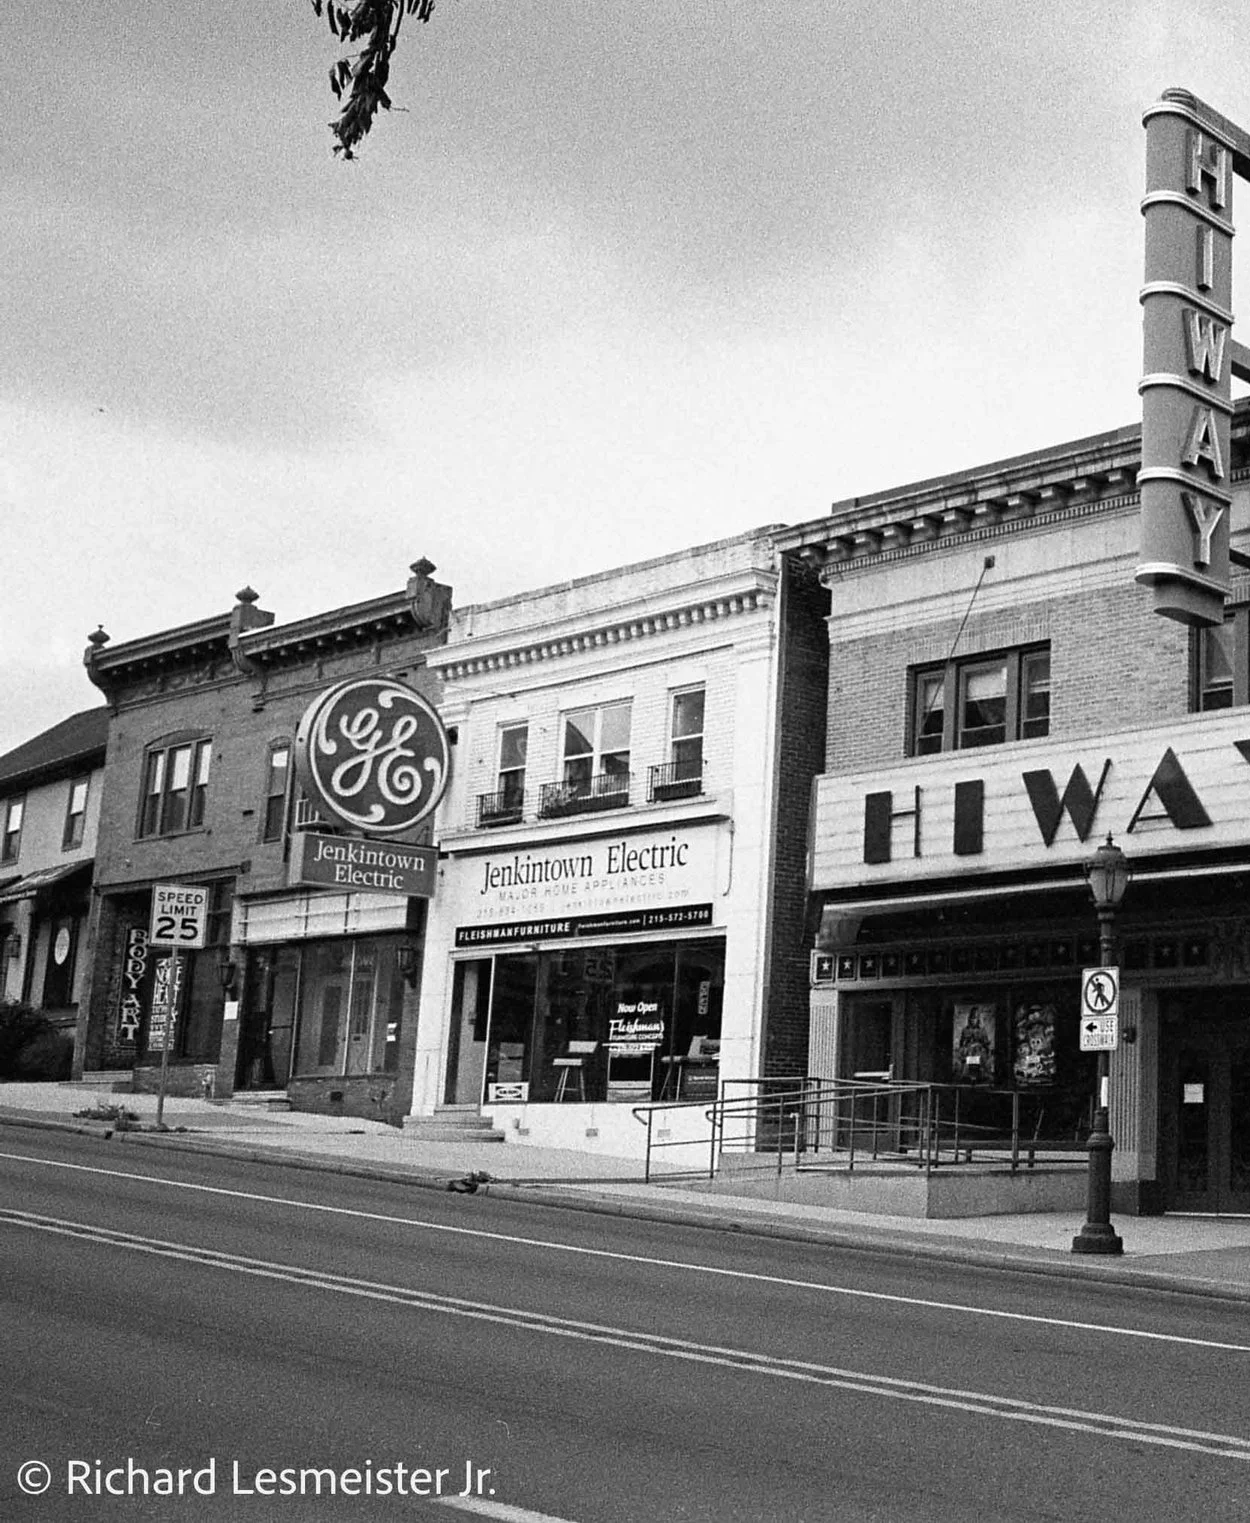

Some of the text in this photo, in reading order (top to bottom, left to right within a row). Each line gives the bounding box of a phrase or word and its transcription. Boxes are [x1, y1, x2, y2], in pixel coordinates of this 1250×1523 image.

[1181, 127, 1227, 567] HIWAY
[314, 840, 425, 871] Jenkintown
[480, 836, 689, 895] Jenkintown Electric
[334, 864, 405, 890] Electric
[545, 882, 579, 897] HOME
[583, 872, 665, 892] APPLIANCES
[157, 891, 204, 905] SPEED
[160, 903, 198, 917] LIMIT
[155, 916, 199, 941] 25
[459, 921, 571, 941] FLEISHMANFURNITURE
[648, 910, 709, 925] 215-572-5700
[124, 928, 149, 989] BODY
[120, 994, 142, 1041] ART
[617, 1001, 658, 1015] Now Open
